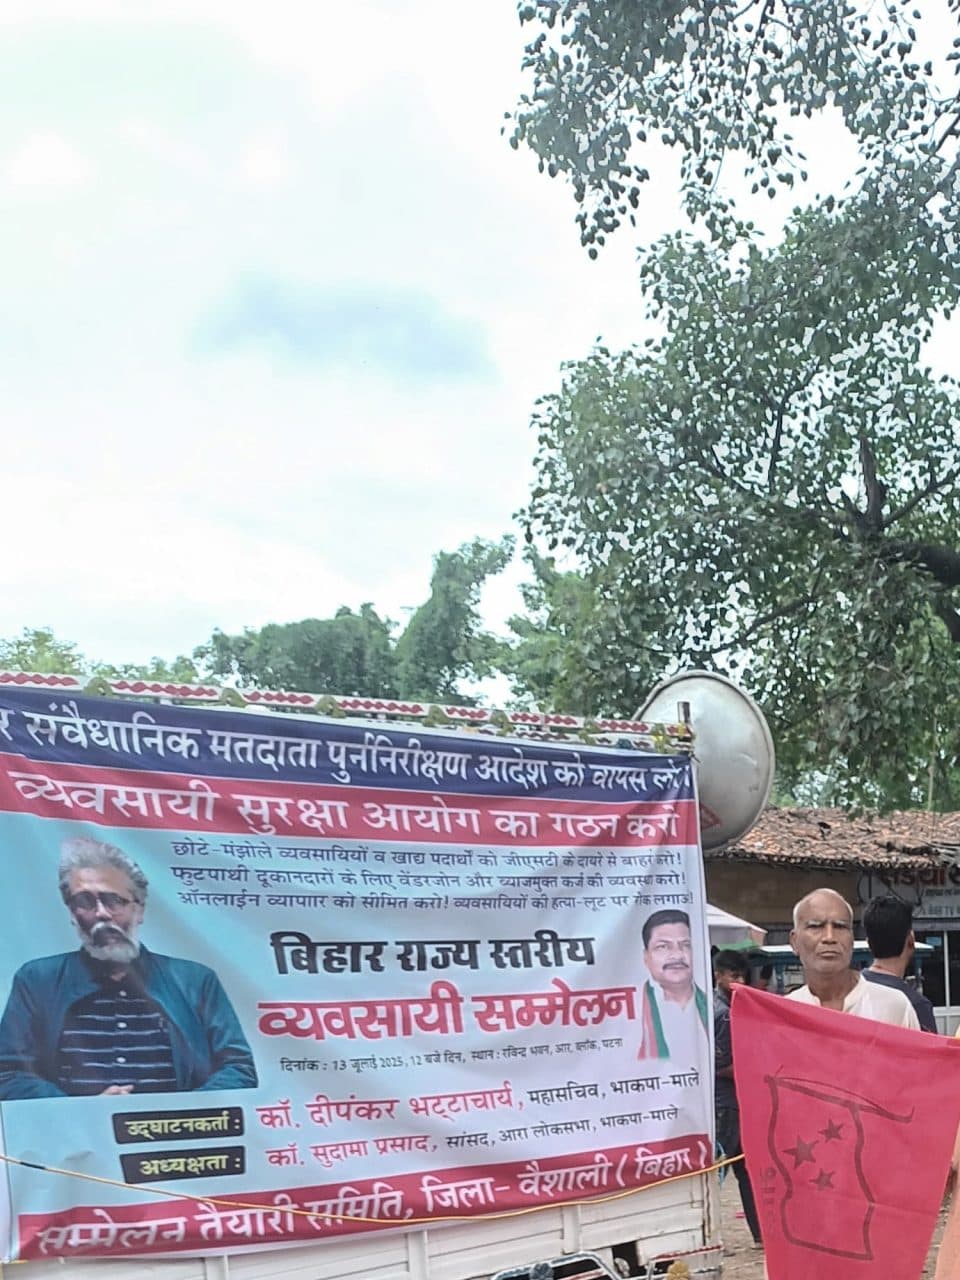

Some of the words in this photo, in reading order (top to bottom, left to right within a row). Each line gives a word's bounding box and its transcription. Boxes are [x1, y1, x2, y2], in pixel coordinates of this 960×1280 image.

[22, 701, 202, 760] संवैधानिक
[206, 729, 322, 771] मतदाता
[475, 747, 548, 790] आदेश
[552, 753, 585, 788] को
[592, 763, 648, 791] वापस
[8, 770, 221, 822] व्यवसायी
[230, 793, 348, 836] सुरक्षा
[362, 796, 480, 836] आयोग
[490, 809, 539, 838] का
[549, 812, 620, 839] गठन
[627, 804, 680, 839] करो
[170, 865, 249, 886] फुटपाथी
[338, 869, 357, 885] के
[360, 869, 397, 890] लिए
[465, 872, 492, 888] और
[586, 872, 603, 887] की
[372, 851, 385, 863] व
[477, 850, 498, 866] को
[501, 851, 558, 870] जीएसटी
[562, 852, 575, 867] के
[606, 852, 617, 866] से
[332, 891, 355, 908] को
[360, 892, 408, 909] सीमित
[531, 894, 548, 910] की
[611, 895, 630, 906] पर
[270, 931, 387, 974] बिहार
[397, 939, 480, 972] राज्य
[488, 929, 595, 968] स्तरीय
[257, 980, 464, 1041] व्यवसायी
[472, 978, 636, 1031] सम्मेलन
[280, 1057, 320, 1071] दिनांक
[333, 1060, 347, 1071] 13
[410, 1055, 422, 1066] 12
[256, 1099, 299, 1129] कॉ.
[305, 1095, 399, 1125] दीपंकर
[527, 1080, 606, 1105] महासचिव,
[610, 1067, 700, 1095] भाकपा-माले
[140, 1154, 230, 1176] अध्यक्षता
[266, 1142, 305, 1167] कॉ.
[310, 1140, 368, 1168] सुदामा
[374, 1134, 438, 1157] प्रसाद,
[446, 1130, 496, 1149] सांसद,
[499, 1128, 528, 1142] आरा
[531, 1117, 596, 1138] लोकसभा,
[600, 1104, 678, 1127] भाकपा-माले
[36, 1209, 188, 1254] सम्मेलन
[195, 1194, 298, 1240] तैयारी
[304, 1181, 412, 1231] समिति,
[517, 1154, 612, 1197] वैशाली
[634, 1146, 693, 1180] बिहार
